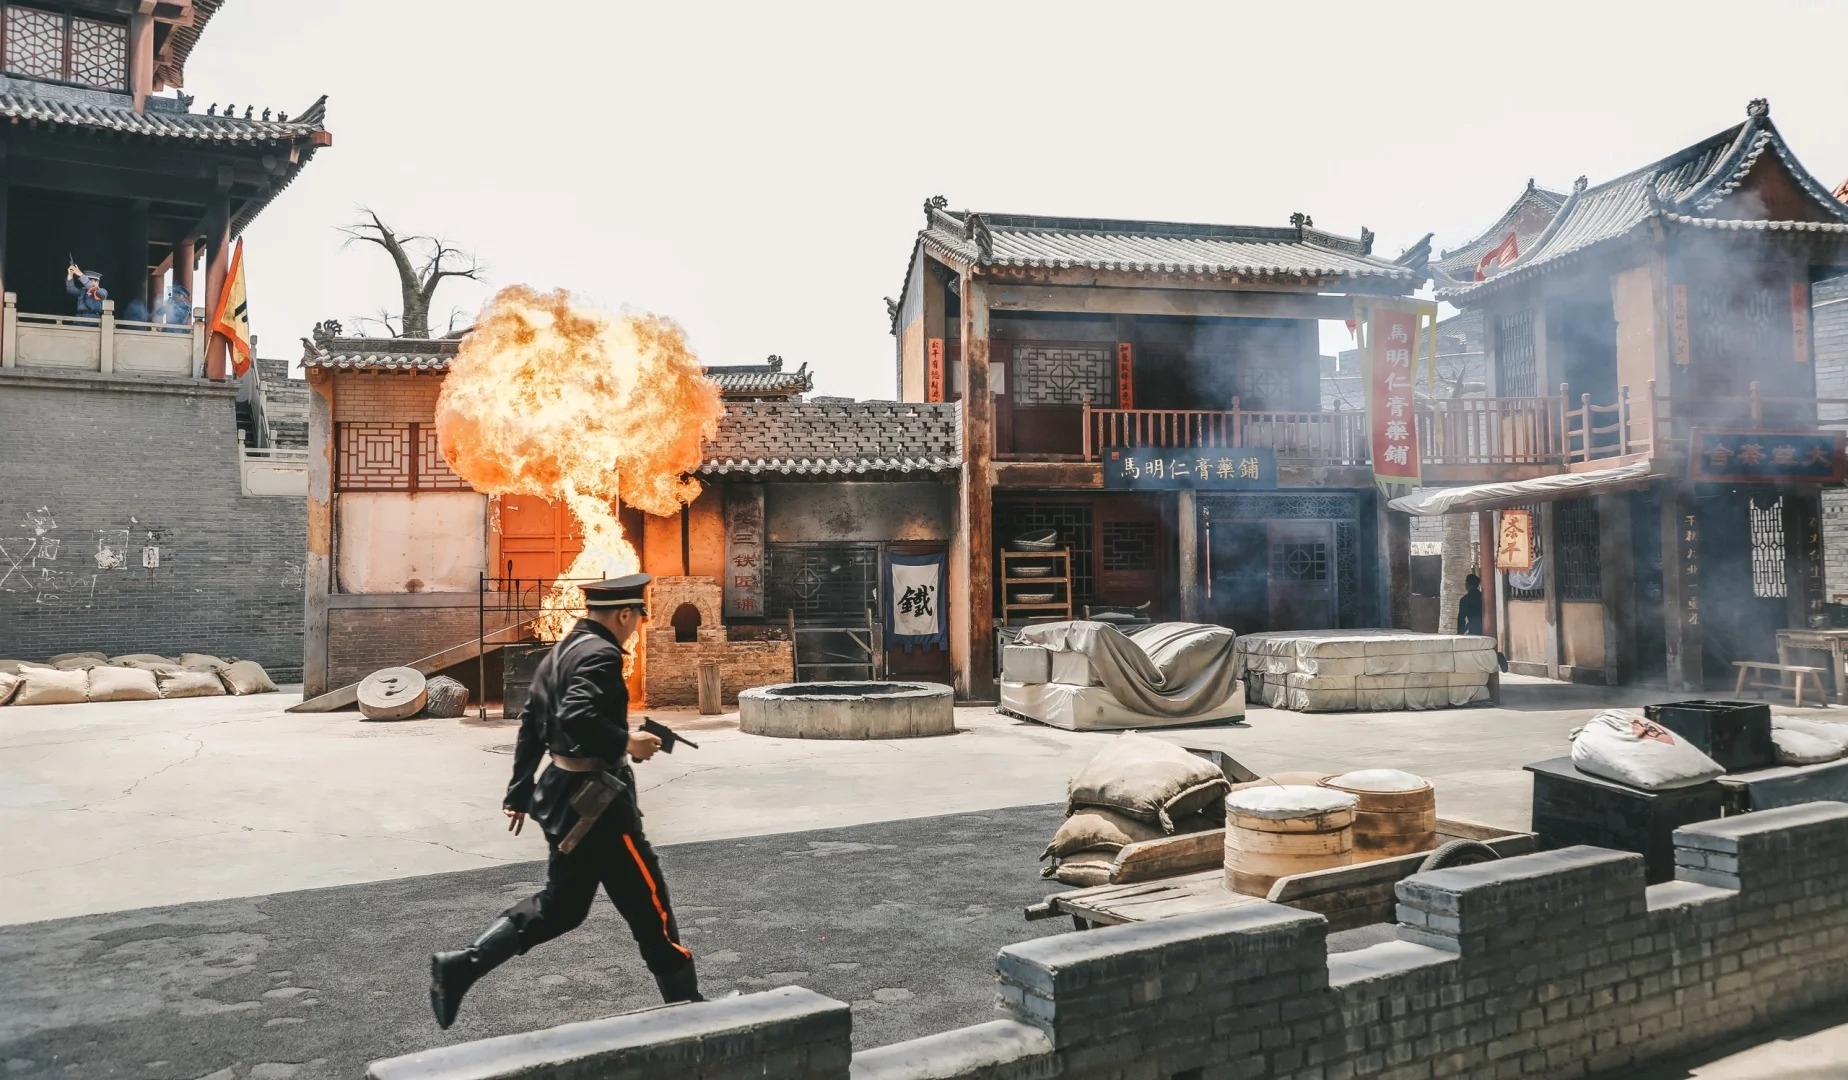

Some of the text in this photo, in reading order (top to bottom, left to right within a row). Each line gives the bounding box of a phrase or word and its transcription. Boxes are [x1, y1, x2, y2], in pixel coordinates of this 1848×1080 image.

[1383, 323, 1410, 466] 馬明仁膏藥鋪
[1120, 456, 1260, 481] 馬明仁膏藥鋪
[897, 584, 935, 617] 鐵
